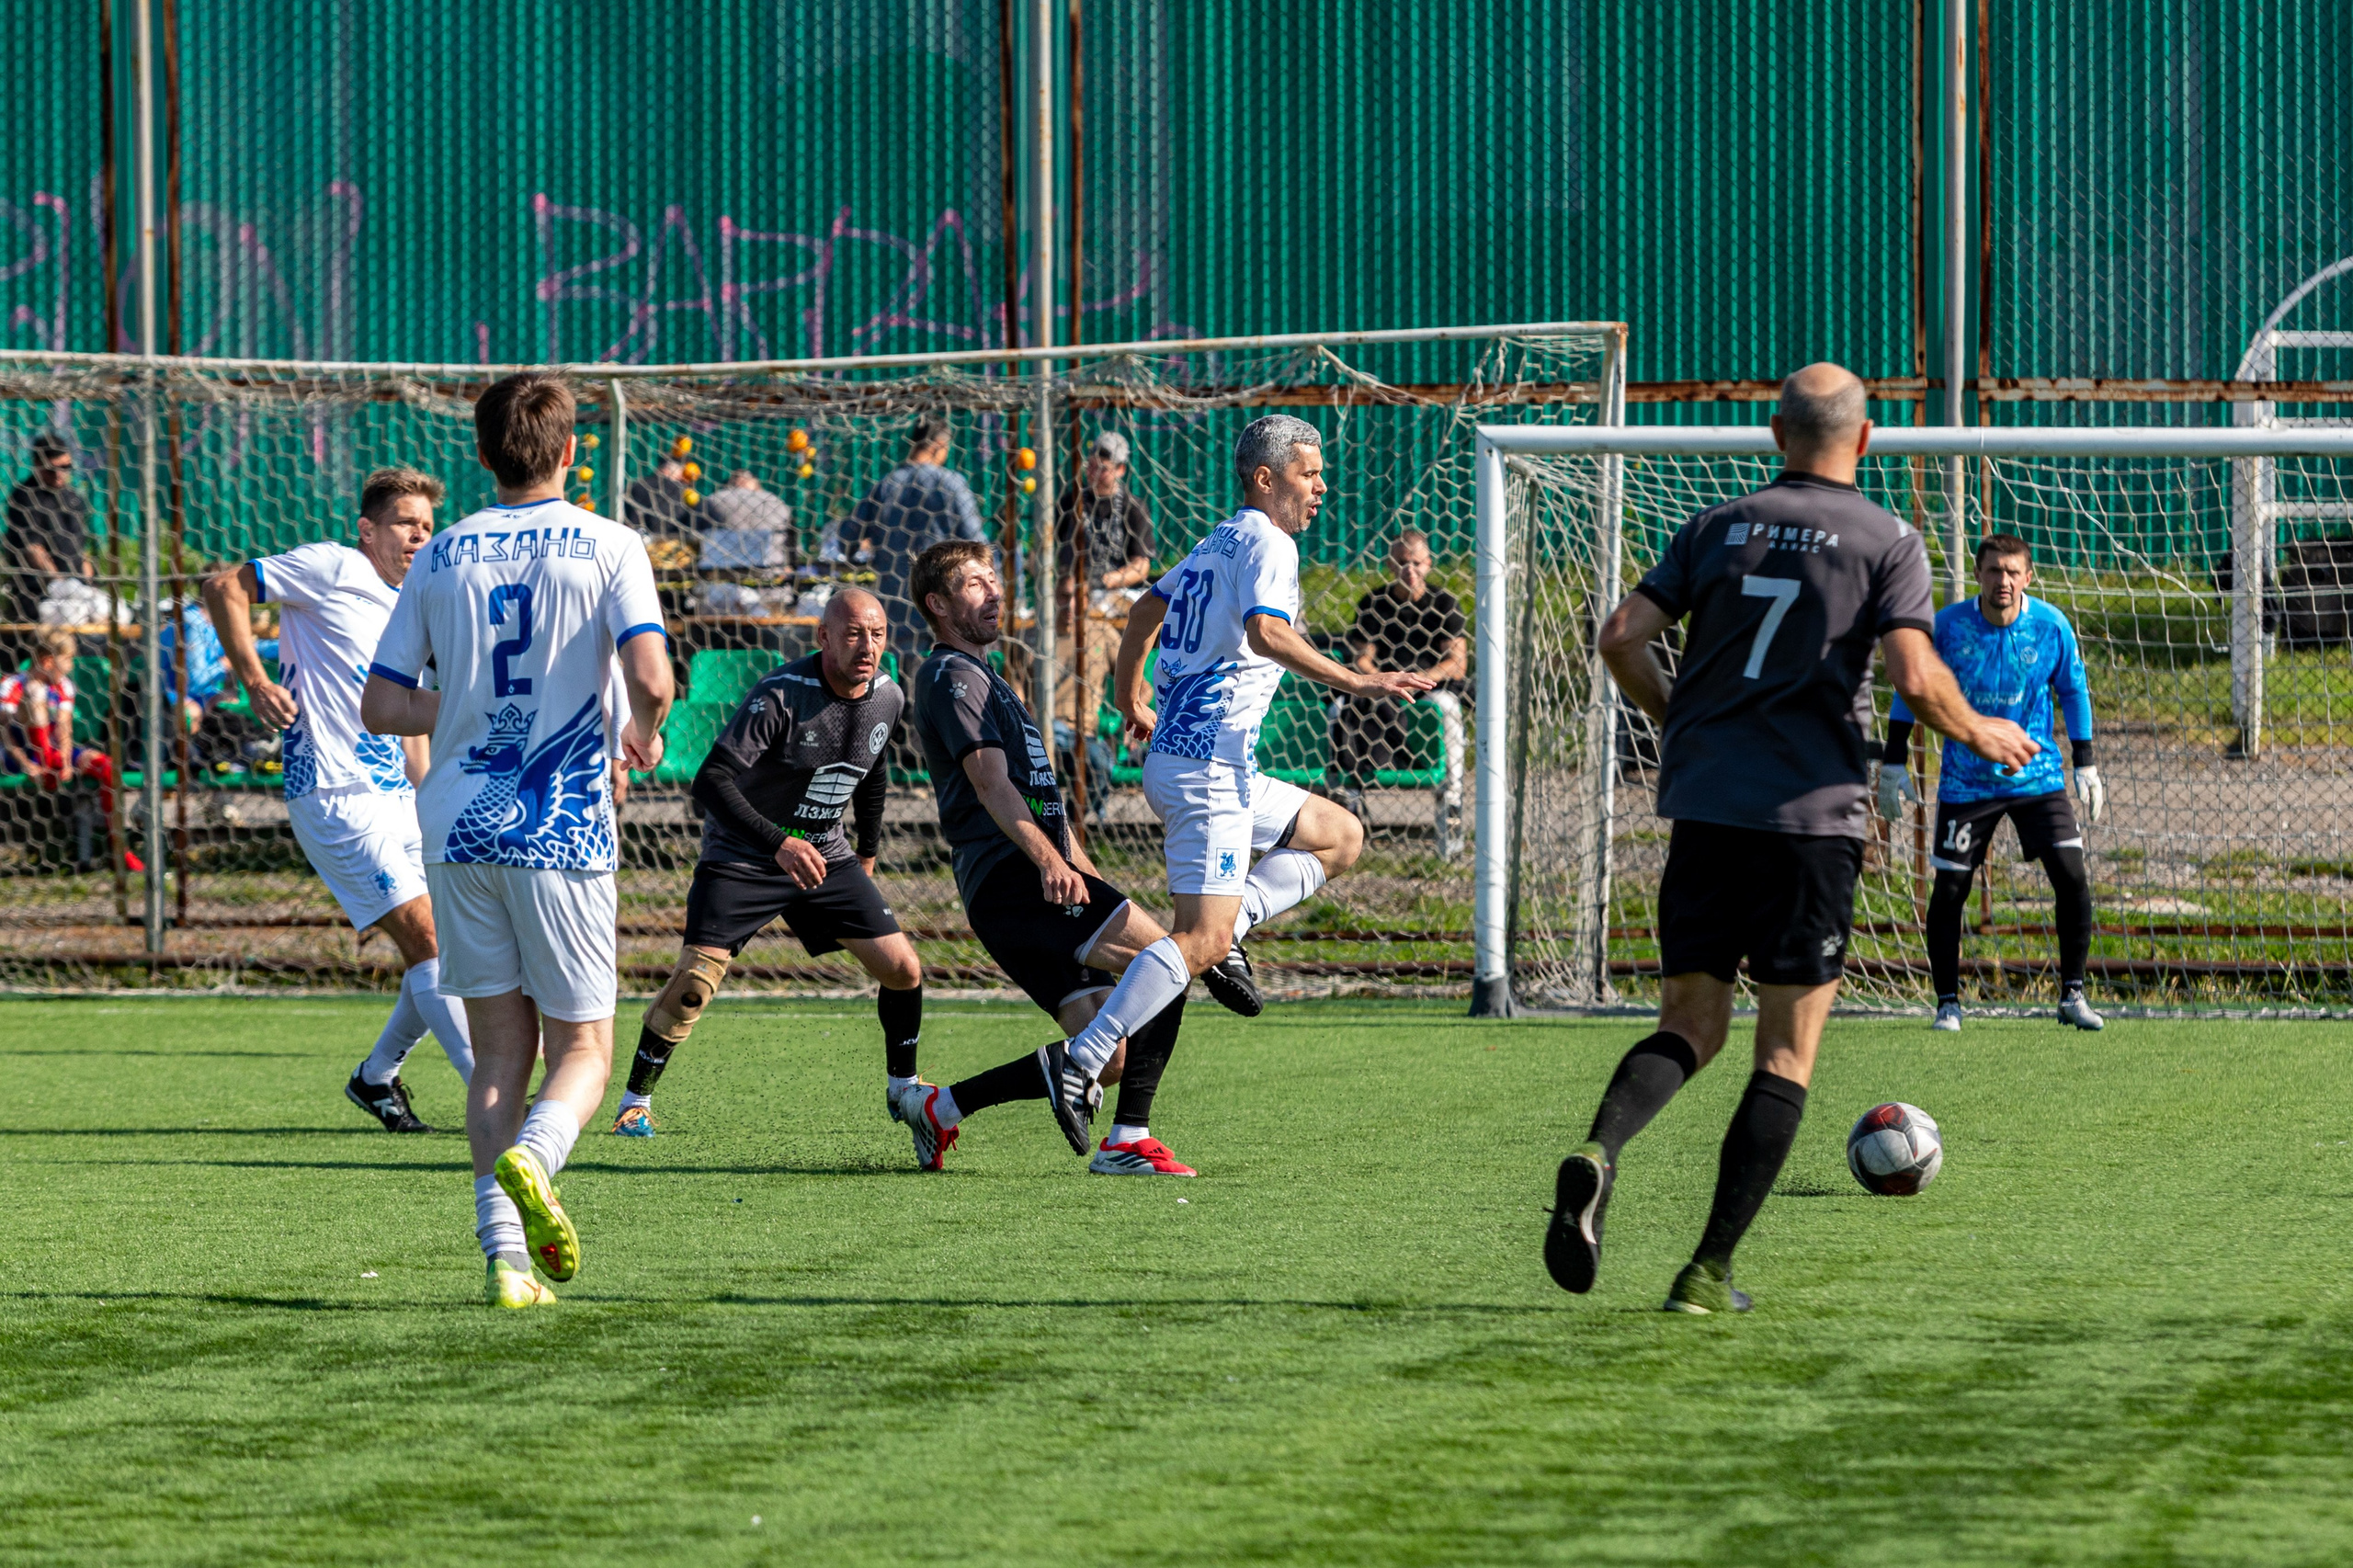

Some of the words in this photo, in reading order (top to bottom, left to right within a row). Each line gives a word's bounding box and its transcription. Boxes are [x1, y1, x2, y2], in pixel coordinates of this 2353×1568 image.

[431, 527, 597, 573] КАЗАНЬ
[1752, 523, 1838, 547] РИМЕРА
[1161, 568, 1215, 653] 30
[1742, 575, 1801, 679] 7
[489, 584, 532, 698] 2
[793, 803, 844, 819] ЛЗЖБ
[1943, 820, 1972, 853] 16
